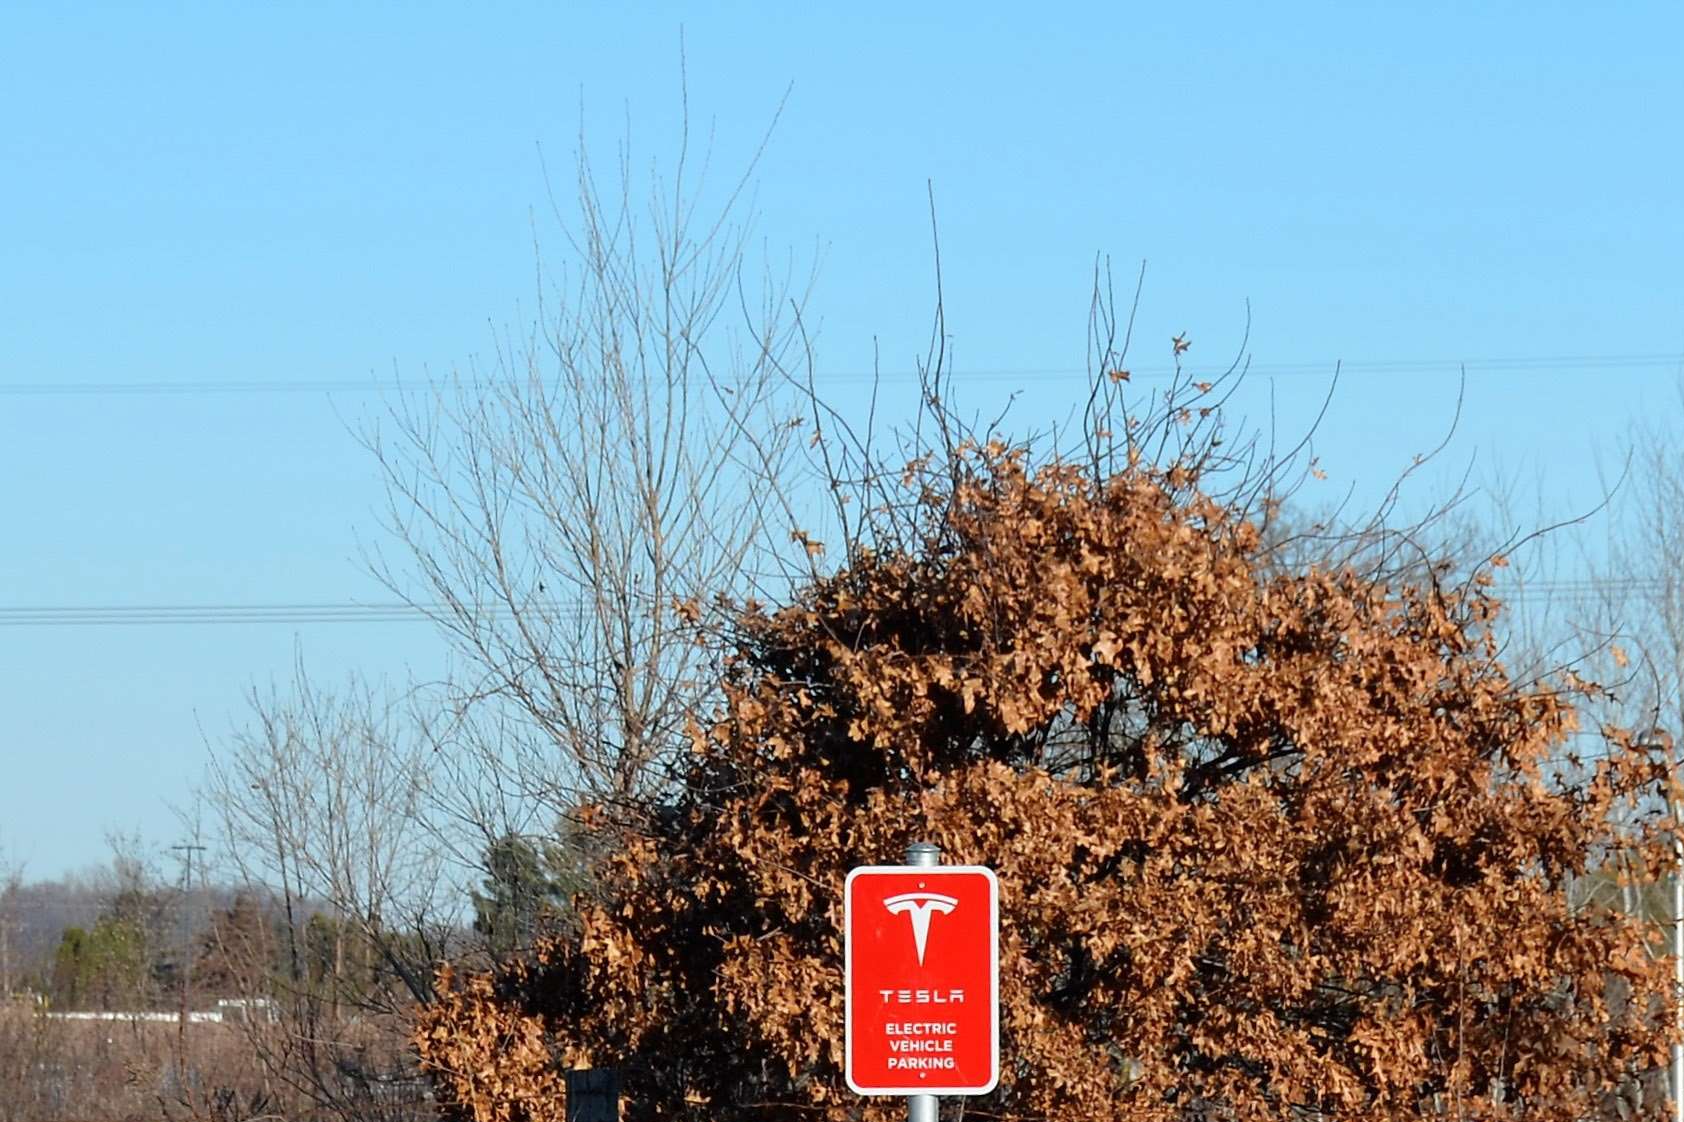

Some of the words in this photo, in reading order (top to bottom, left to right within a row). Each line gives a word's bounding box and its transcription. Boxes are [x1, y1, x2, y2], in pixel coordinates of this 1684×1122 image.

[879, 989, 964, 1004] TESLA
[885, 1022, 957, 1035] ELECTRIC
[889, 1039, 953, 1052] VEHICLE
[887, 1057, 955, 1070] PARKING
